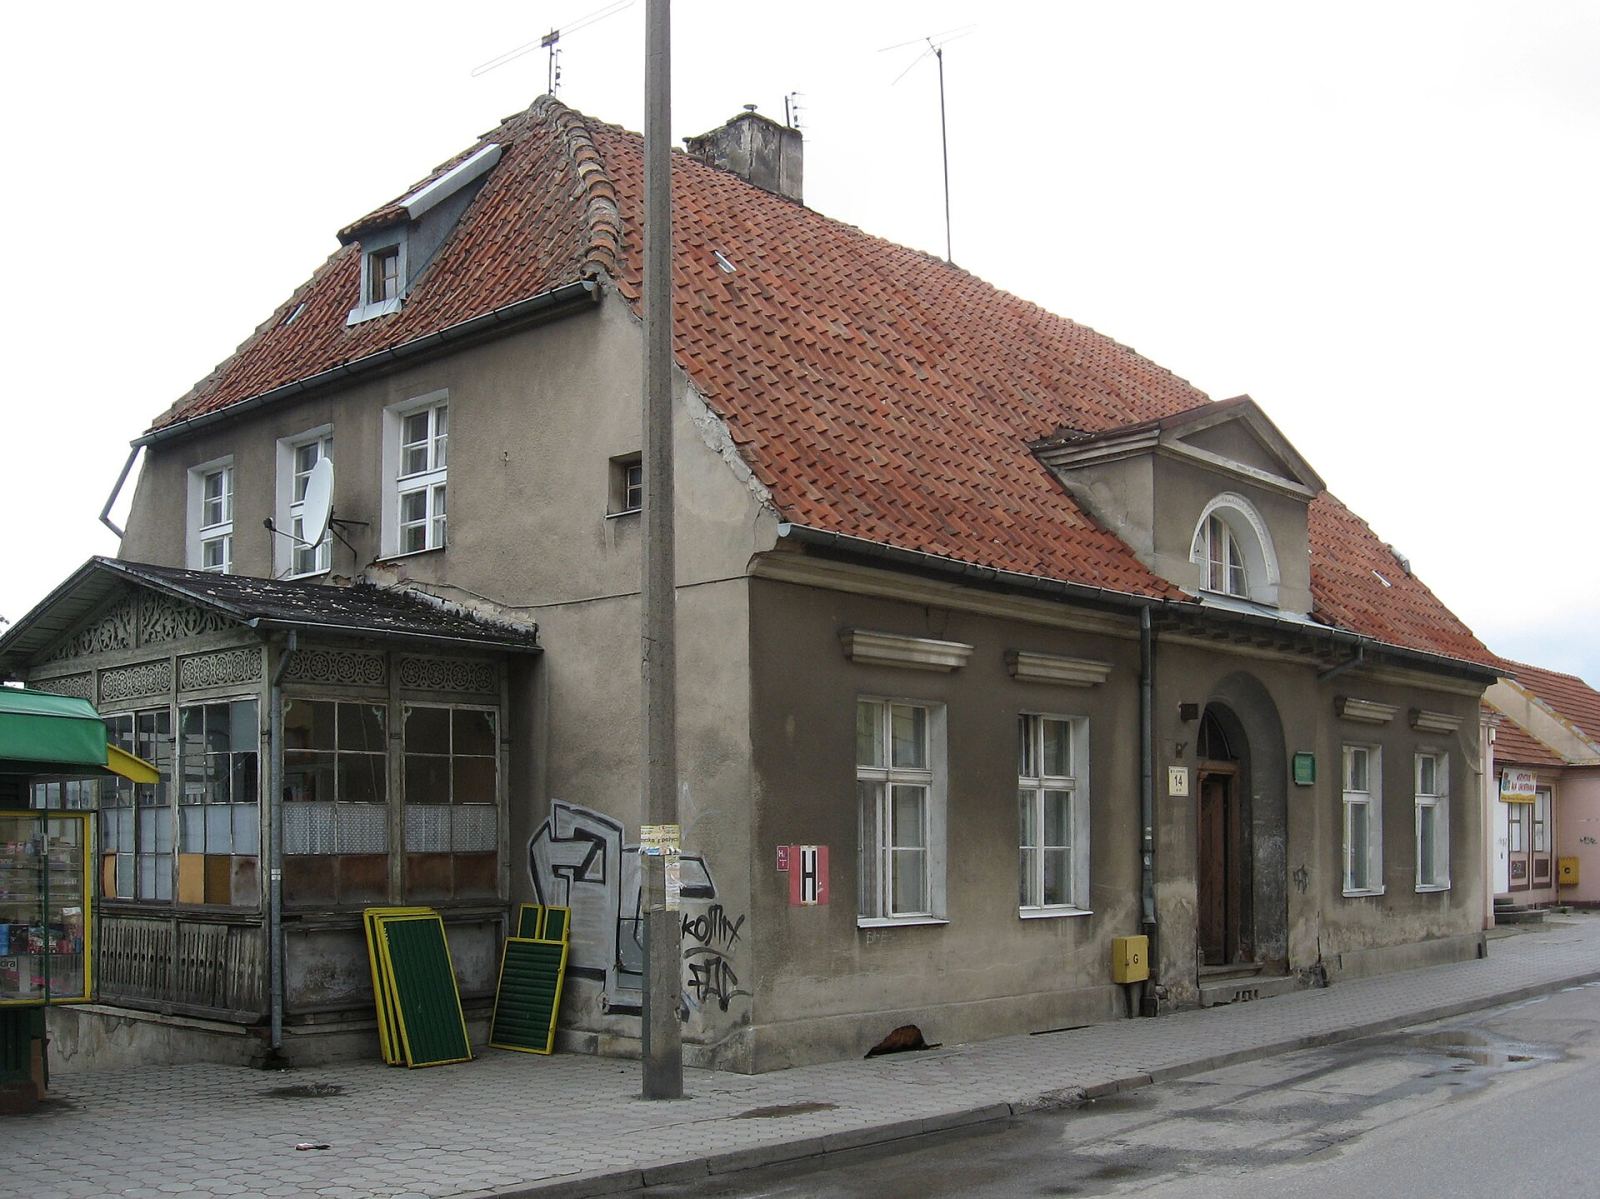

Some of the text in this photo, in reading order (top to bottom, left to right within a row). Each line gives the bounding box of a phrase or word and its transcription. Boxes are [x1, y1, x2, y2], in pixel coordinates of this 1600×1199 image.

[1174, 775, 1183, 786] 14
[802, 850, 816, 902] H
[1132, 953, 1139, 965] G
